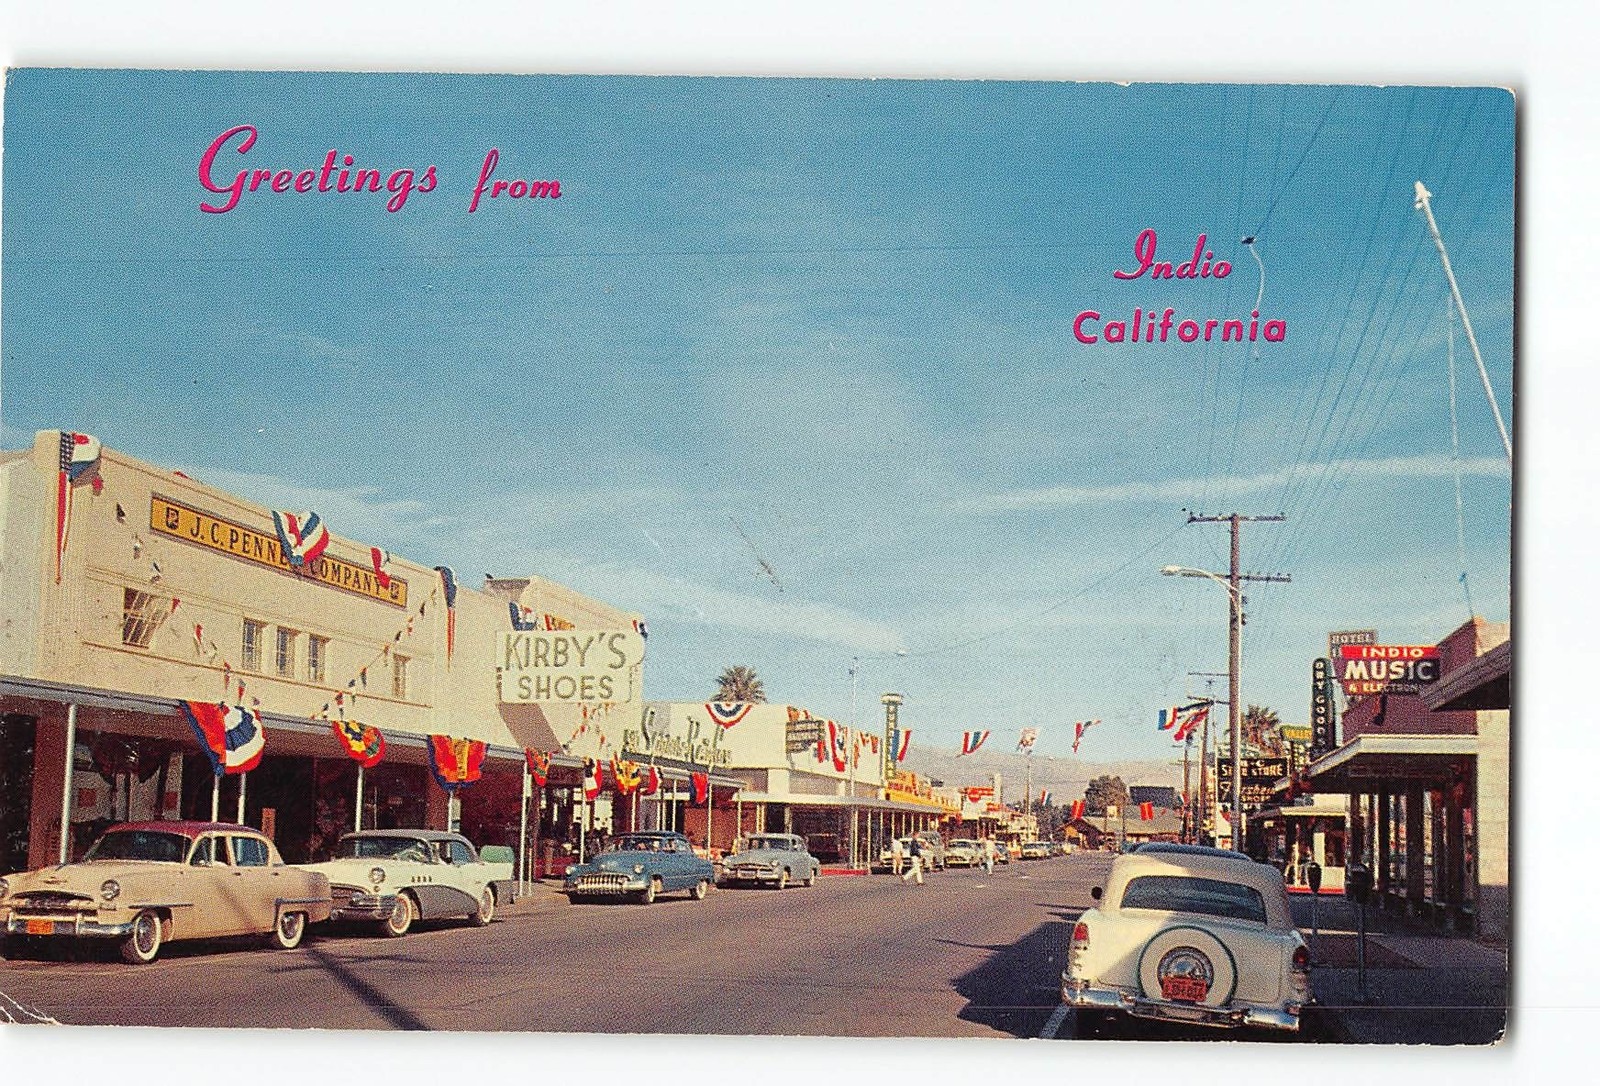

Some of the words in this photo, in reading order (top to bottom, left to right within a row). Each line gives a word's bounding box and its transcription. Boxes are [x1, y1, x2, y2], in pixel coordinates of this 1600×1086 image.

[229, 528, 291, 567] PENNE
[1331, 632, 1372, 644] HOTEL
[505, 632, 627, 671] KIRBY'S
[1361, 647, 1424, 658] INDIO
[1344, 660, 1433, 680] MUSIC
[518, 675, 614, 700] SHOES
[1251, 763, 1283, 776] STORE
